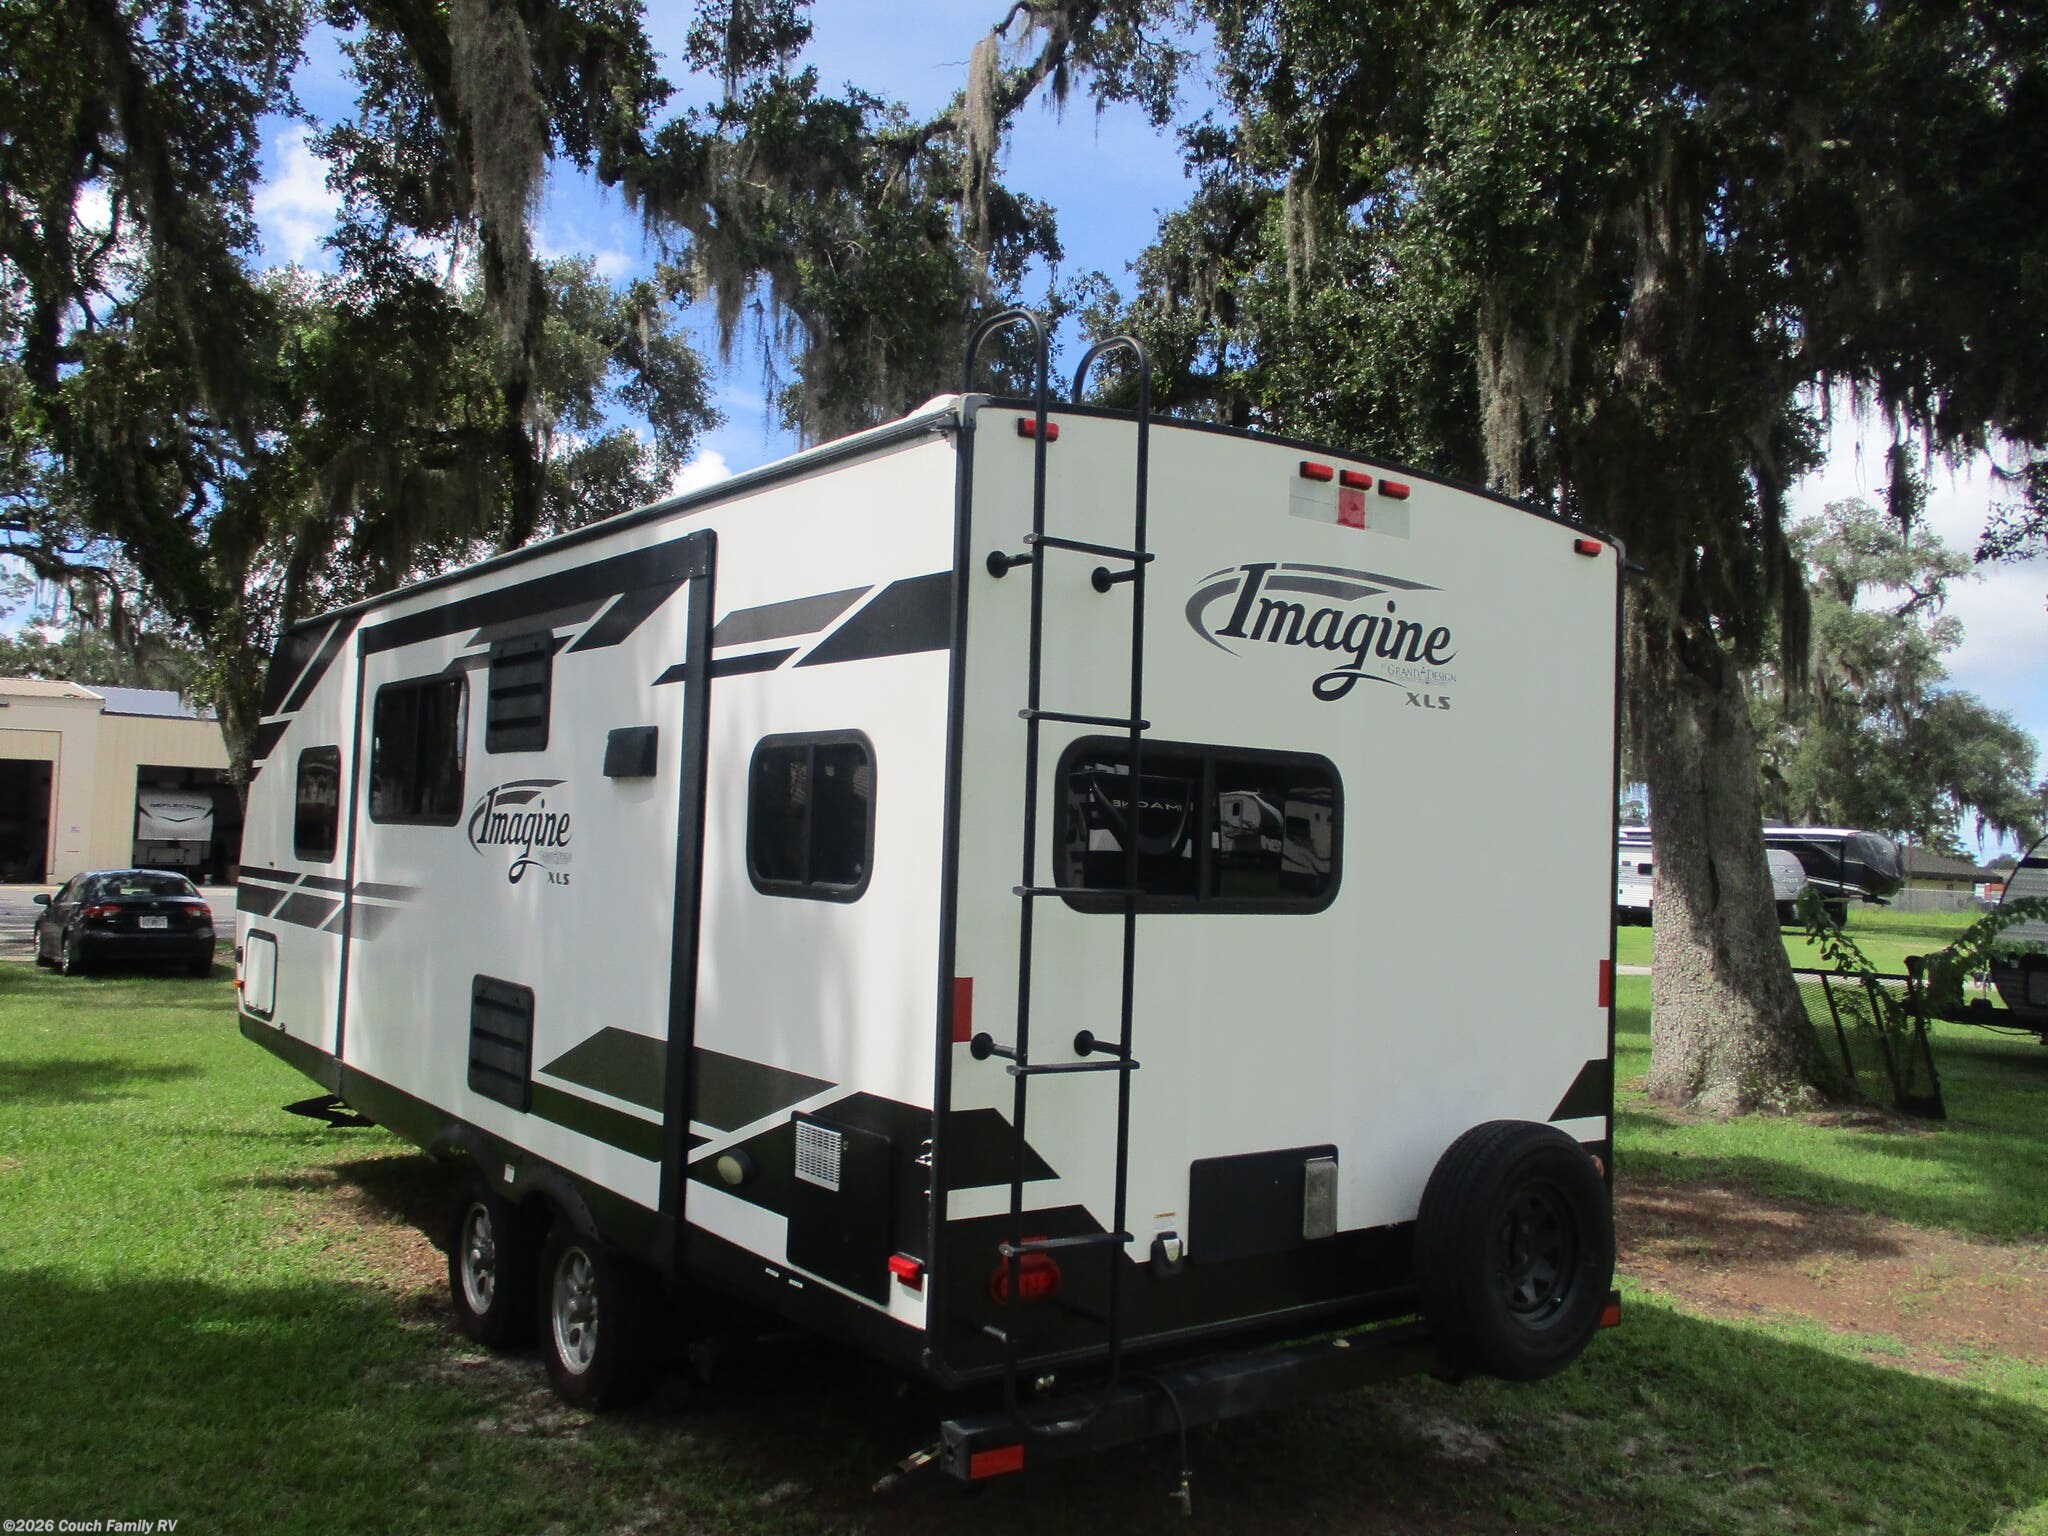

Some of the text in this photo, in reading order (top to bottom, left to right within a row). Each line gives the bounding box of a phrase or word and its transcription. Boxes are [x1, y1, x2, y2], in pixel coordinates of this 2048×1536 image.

[1215, 562, 1459, 701] Imagine
[1387, 664, 1420, 678] GRAND
[1427, 668, 1457, 682] DESIGN
[1405, 692, 1451, 710] XLS
[477, 786, 573, 884] Imagine
[547, 872, 570, 885] XLS
